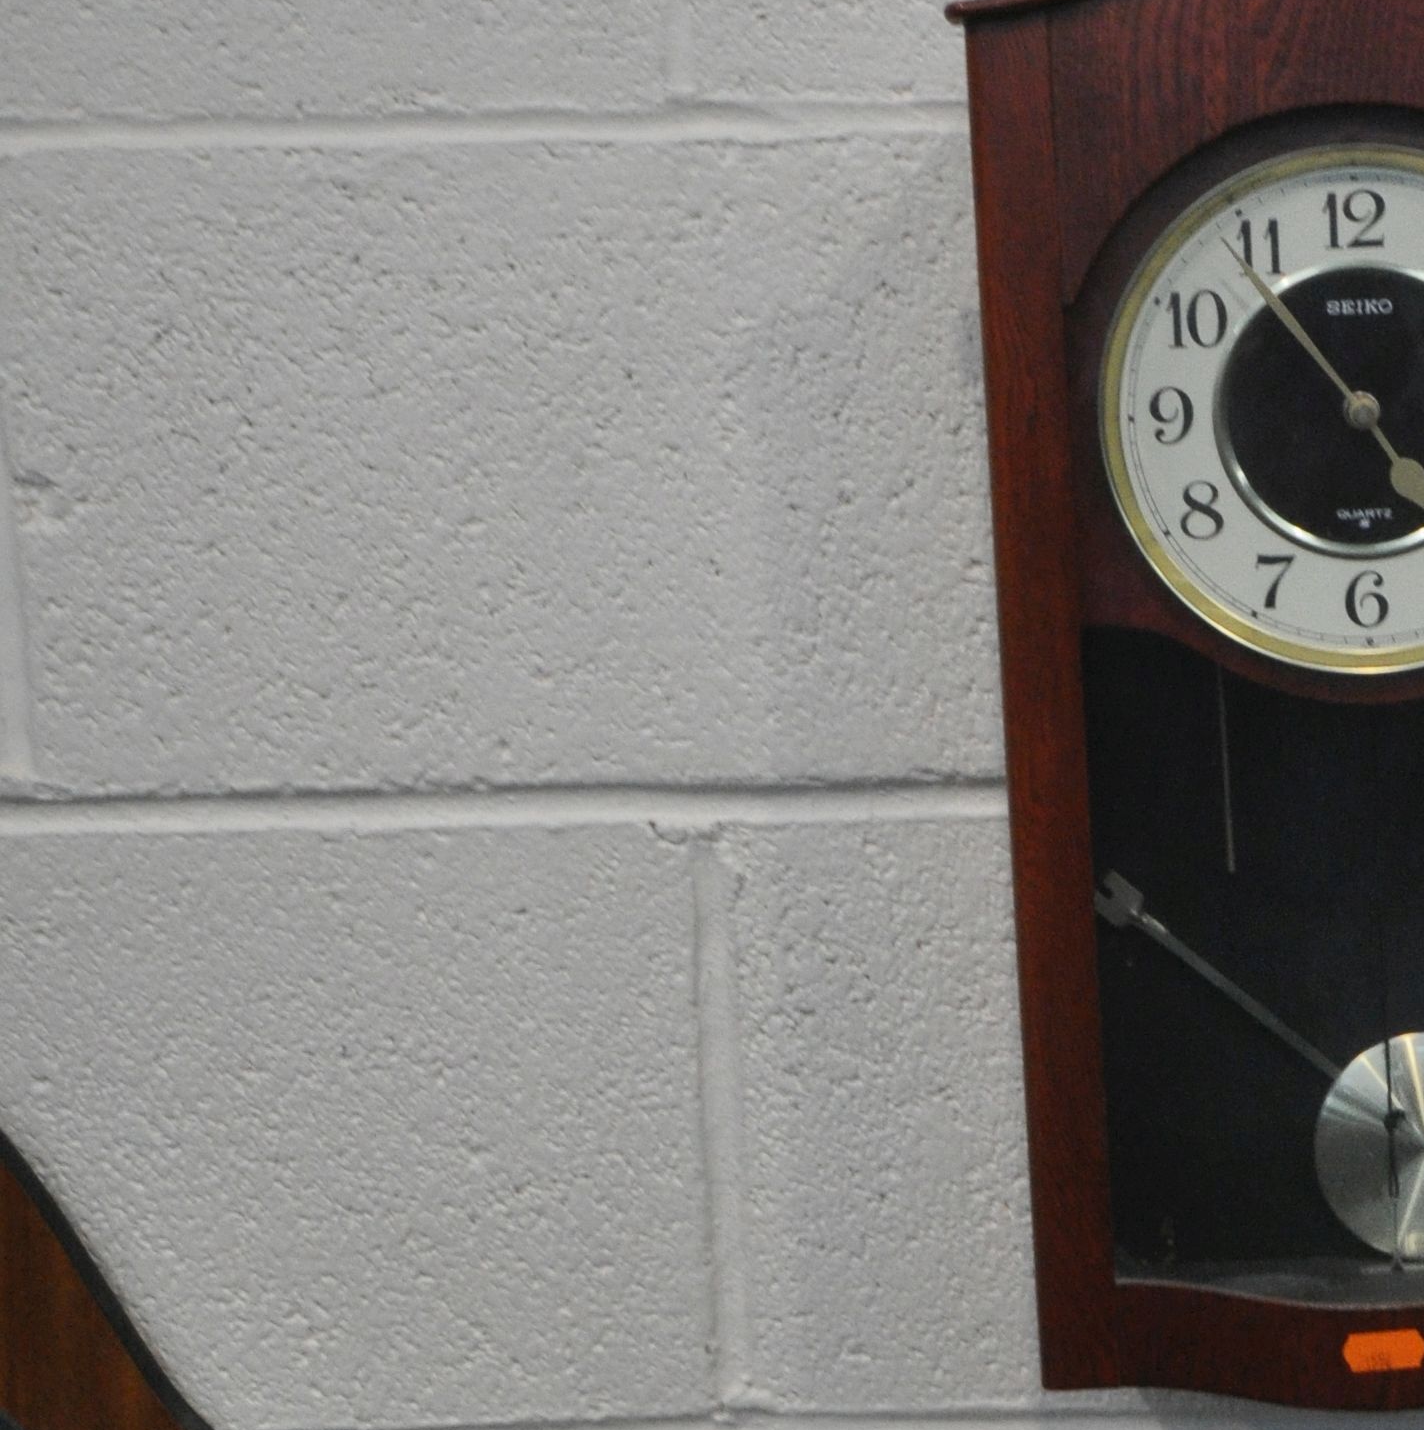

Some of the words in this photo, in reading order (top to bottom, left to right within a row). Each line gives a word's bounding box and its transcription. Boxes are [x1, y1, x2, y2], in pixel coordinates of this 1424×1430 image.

[1237, 218, 1284, 275] 11
[1322, 189, 1386, 249] 12
[1167, 290, 1228, 348] 10
[1326, 297, 1393, 316] SEIKO
[1150, 387, 1194, 444] 9
[1180, 480, 1224, 540] 8
[1336, 507, 1392, 520] QUARTZ
[1255, 554, 1294, 609] 7
[1345, 571, 1388, 628] 6
